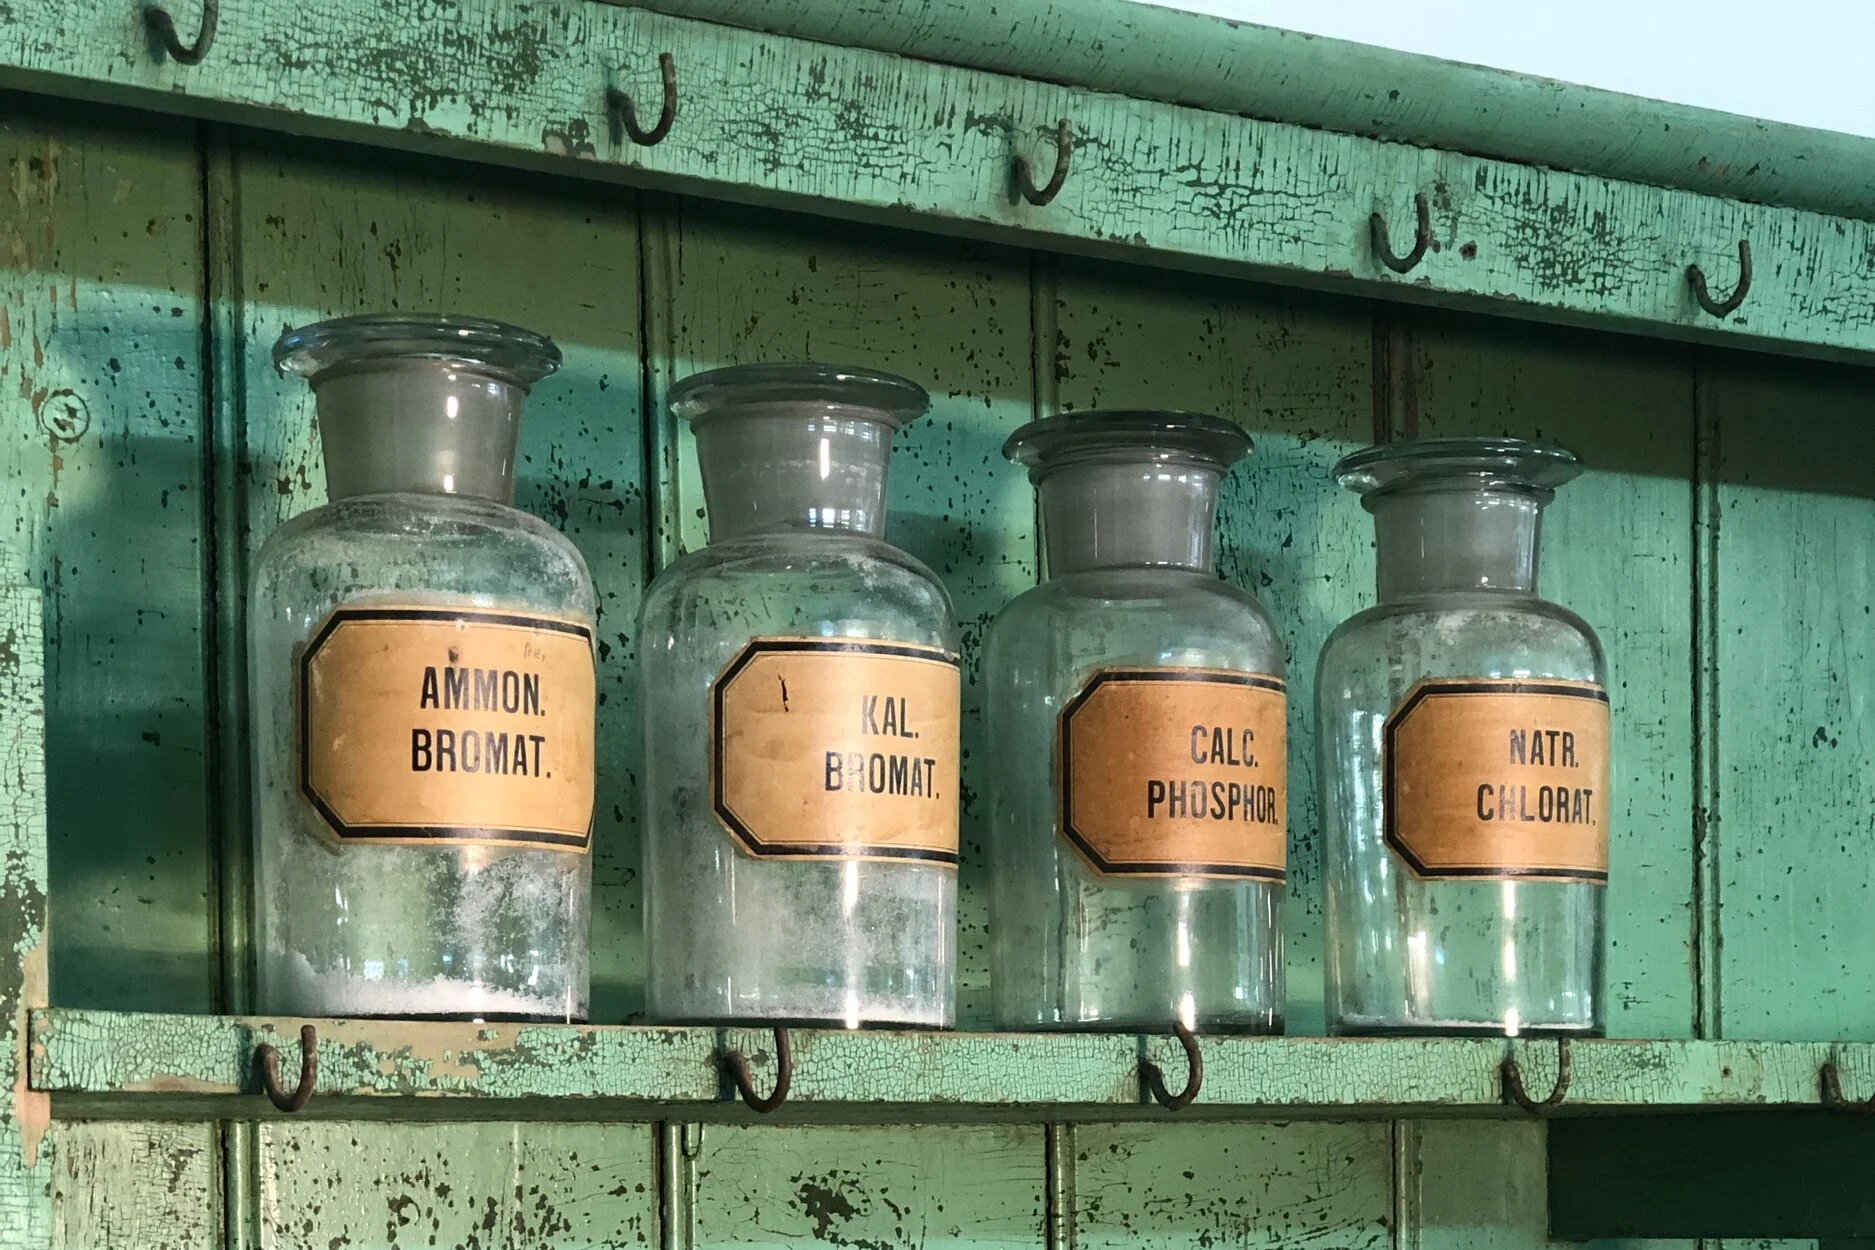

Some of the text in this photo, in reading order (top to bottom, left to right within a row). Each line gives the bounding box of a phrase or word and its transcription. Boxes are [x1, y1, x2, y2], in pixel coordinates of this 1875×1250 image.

[420, 666, 546, 716] AMMON.
[861, 695, 919, 739] KAL.
[411, 728, 551, 779] BROMAT.
[1190, 725, 1259, 768] CALC.
[1509, 729, 1579, 768] NATR.
[824, 751, 940, 800] BROMAT.
[1147, 780, 1278, 825] PHOSPHOR.
[1477, 784, 1596, 826] CHLORAT.
